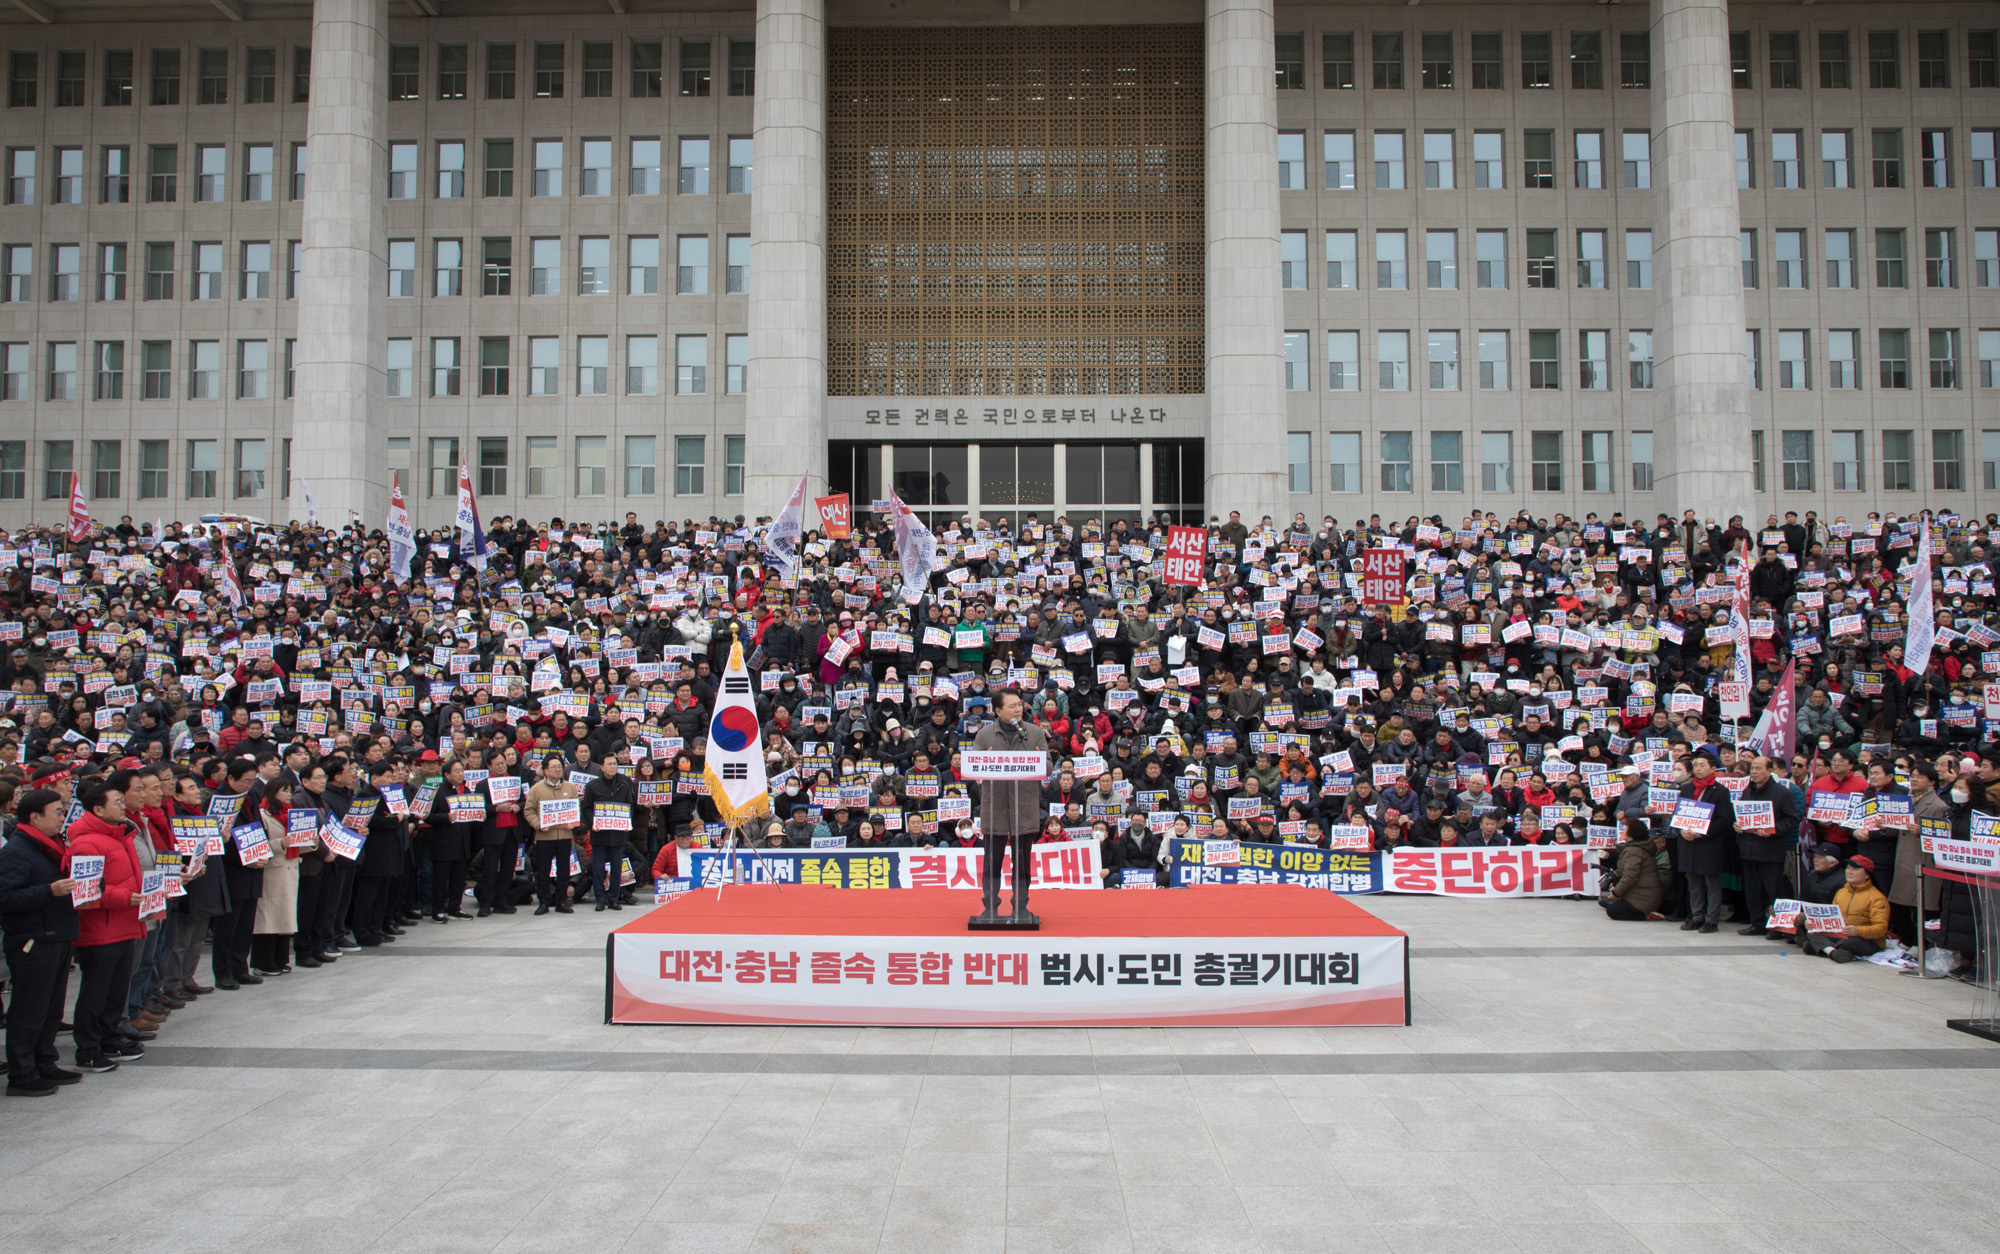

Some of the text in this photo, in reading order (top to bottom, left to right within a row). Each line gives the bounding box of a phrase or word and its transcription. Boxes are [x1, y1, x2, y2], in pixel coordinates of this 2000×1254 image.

[866, 408, 1167, 426] 모든 권력은 국민으로부터 나온다
[821, 503, 848, 526] 예산
[1169, 532, 1204, 556] 서산
[1167, 557, 1202, 583] 태안
[1366, 553, 1402, 576] 서산
[1366, 579, 1402, 601] 태안
[908, 786, 937, 794] 중단하라
[1325, 786, 1351, 794] 결사반대
[639, 794, 653, 803] 결사
[853, 797, 867, 805] 반대!
[1230, 808, 1259, 817] 결사 반대!
[1678, 806, 1711, 818] 강제합병
[1878, 801, 1909, 813] 강제합병
[455, 810, 481, 820] 단하라
[1738, 814, 1771, 827] 결사 반대!
[1879, 814, 1910, 825] 결사반대
[291, 815, 316, 831] 강제합병
[595, 818, 629, 828] 중단하라
[1673, 817, 1706, 829] 결사반대
[238, 828, 266, 848] 강제합병
[290, 829, 316, 844] 결사반대
[322, 829, 356, 855] 결사반대
[1334, 837, 1366, 846] 결사 반대!
[177, 839, 221, 853] 중단라
[1207, 851, 1237, 862] 결사 반대!
[1280, 853, 1324, 872] 이양
[1329, 854, 1371, 872] 없는
[800, 858, 842, 889] 졸속
[849, 856, 890, 889] 통합
[909, 854, 983, 889] 결사
[1393, 850, 1589, 894] 중단하라
[1286, 871, 1372, 892] 강제합병
[1823, 918, 1842, 930] 반대!
[660, 950, 1359, 986] 대전·충남 졸속 통합 반대 범시·도민 총궐기대회
